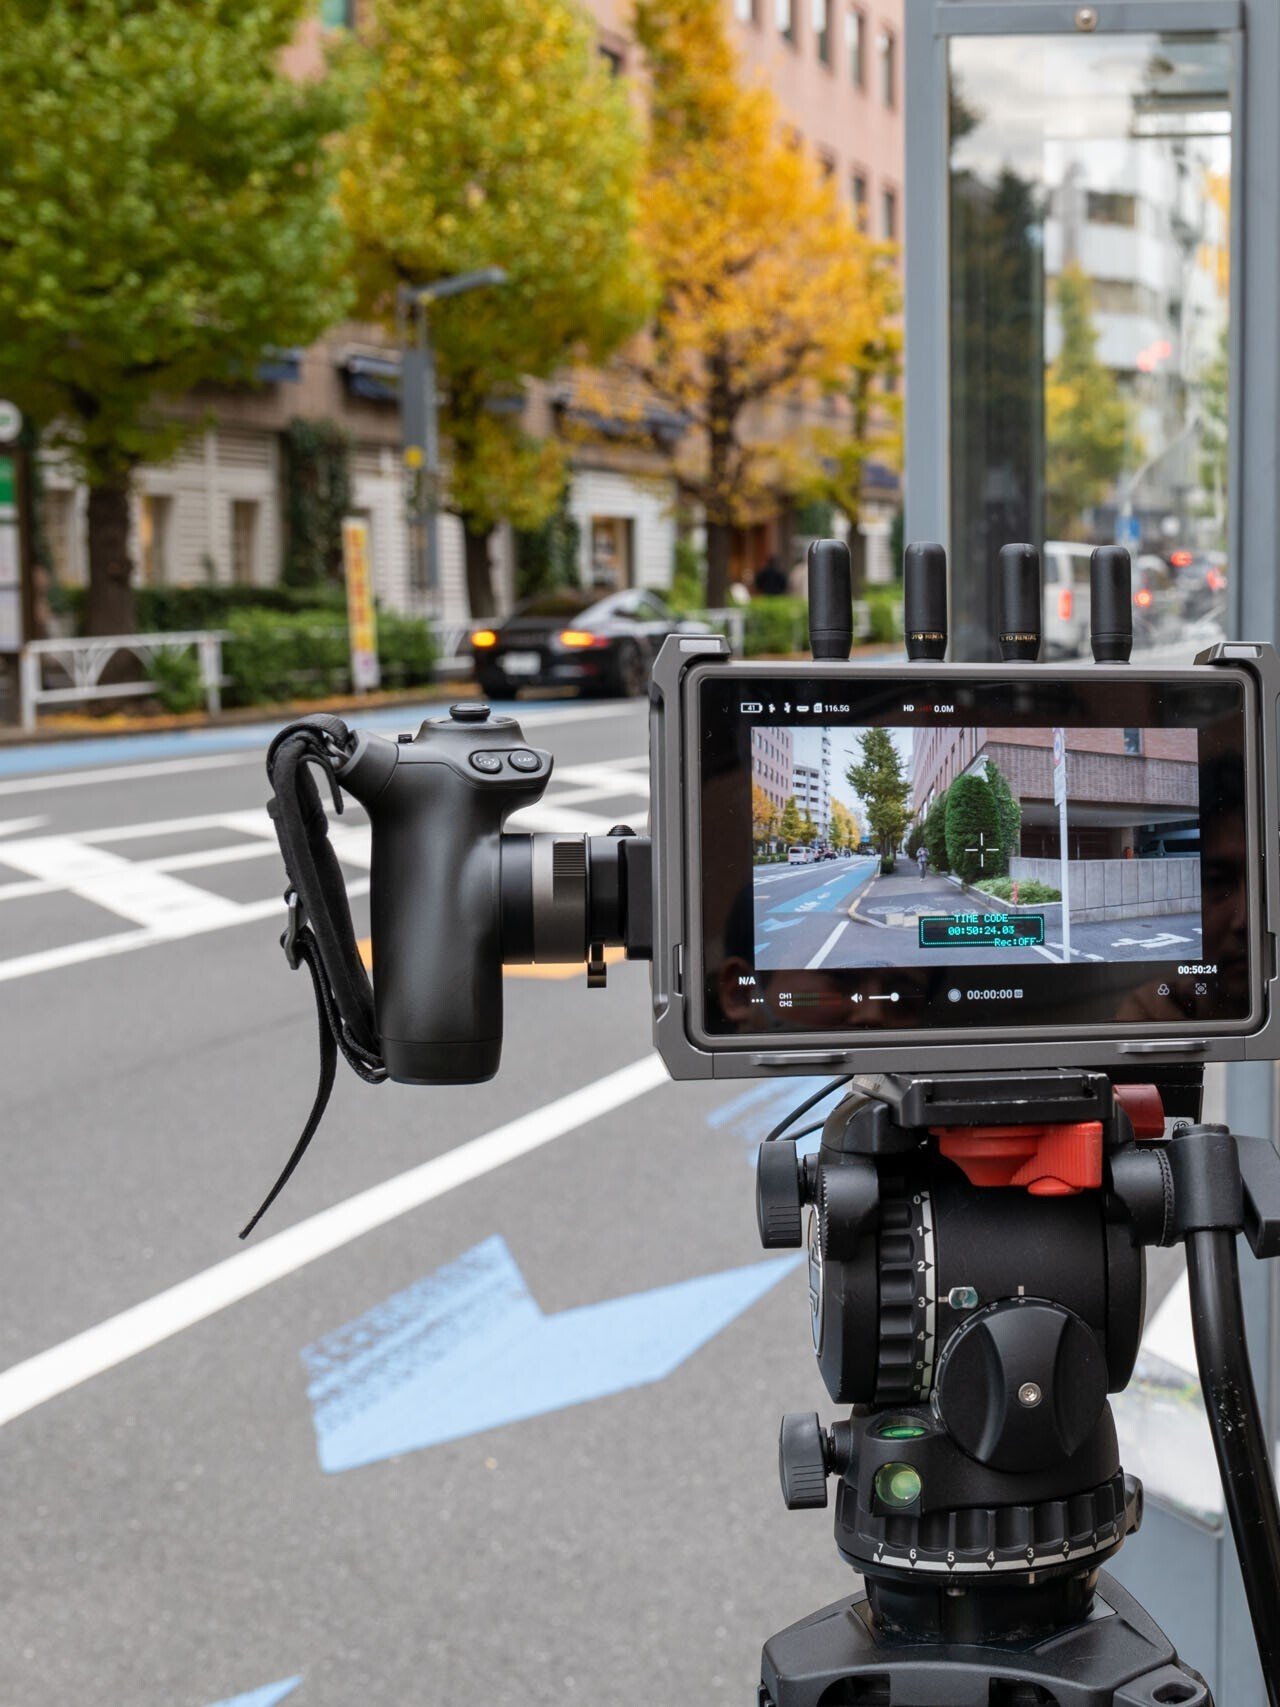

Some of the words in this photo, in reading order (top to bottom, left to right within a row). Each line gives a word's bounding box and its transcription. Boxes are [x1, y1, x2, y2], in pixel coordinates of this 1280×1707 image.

[953, 914, 979, 923] TIME
[984, 914, 1008, 922] CODE
[948, 926, 1015, 935] 00:50:24.03
[994, 937, 1037, 947] Rec:OFF
[1178, 965, 1218, 974] 00:50:24
[738, 976, 756, 985] N/A
[967, 989, 1013, 1000] 00:00:00
[913, 1194, 921, 1204] 0
[916, 1226, 923, 1237] 1
[917, 1260, 926, 1272] 2
[917, 1296, 926, 1308] 3
[917, 1331, 926, 1342] 4
[915, 1361, 924, 1370] 5
[877, 1543, 884, 1553] 7
[909, 1548, 917, 1560] 6
[946, 1551, 955, 1562] 5
[986, 1551, 995, 1562] 4
[1026, 1547, 1035, 1558] 3
[1062, 1541, 1070, 1552] 2
